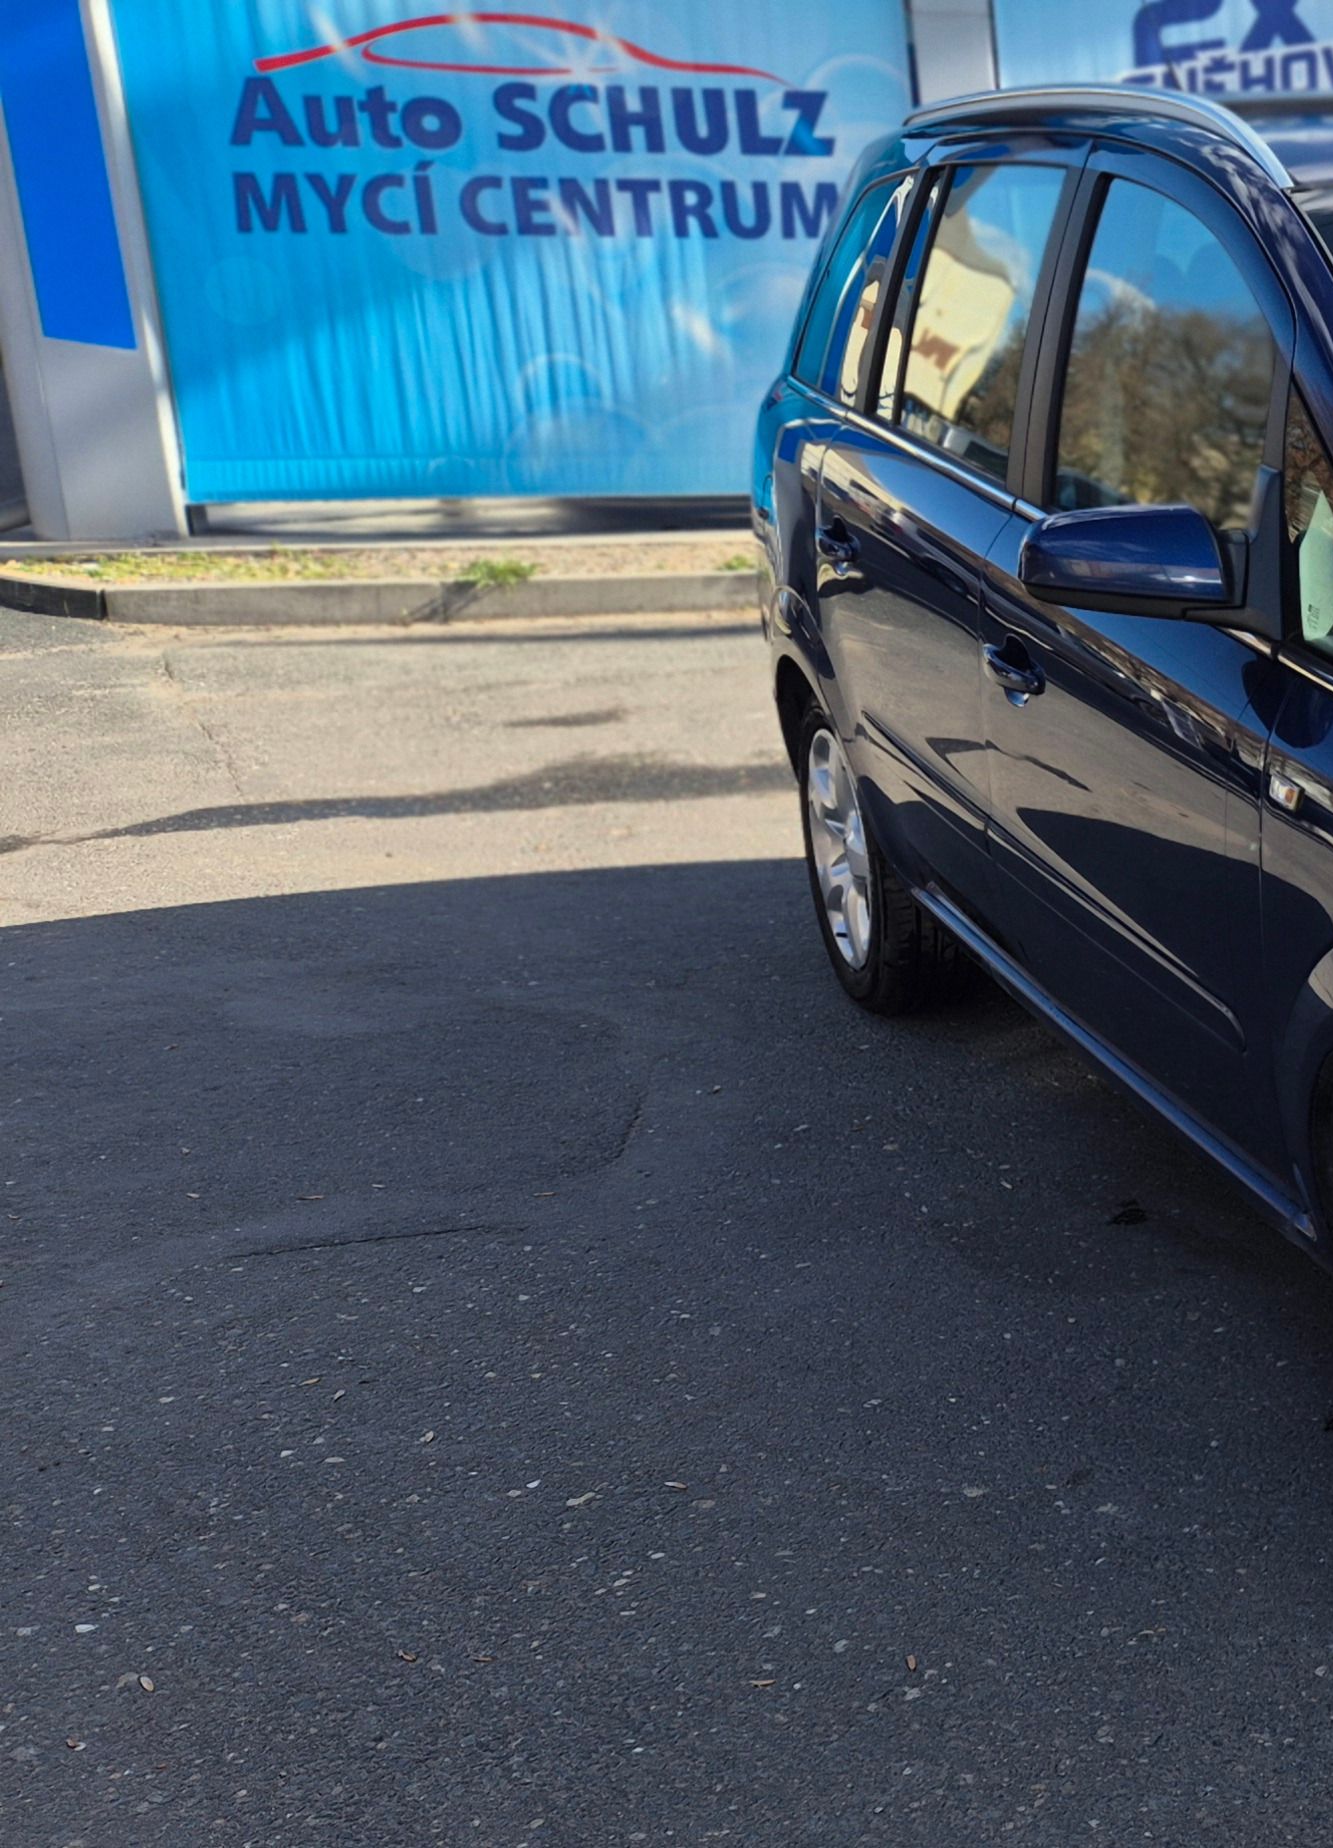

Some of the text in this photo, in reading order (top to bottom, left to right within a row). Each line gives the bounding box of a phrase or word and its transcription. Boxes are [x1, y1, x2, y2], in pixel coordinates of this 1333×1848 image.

[230, 76, 835, 157] Auto SCHULZ
[232, 160, 841, 241] MYCÍ CENTRUM
